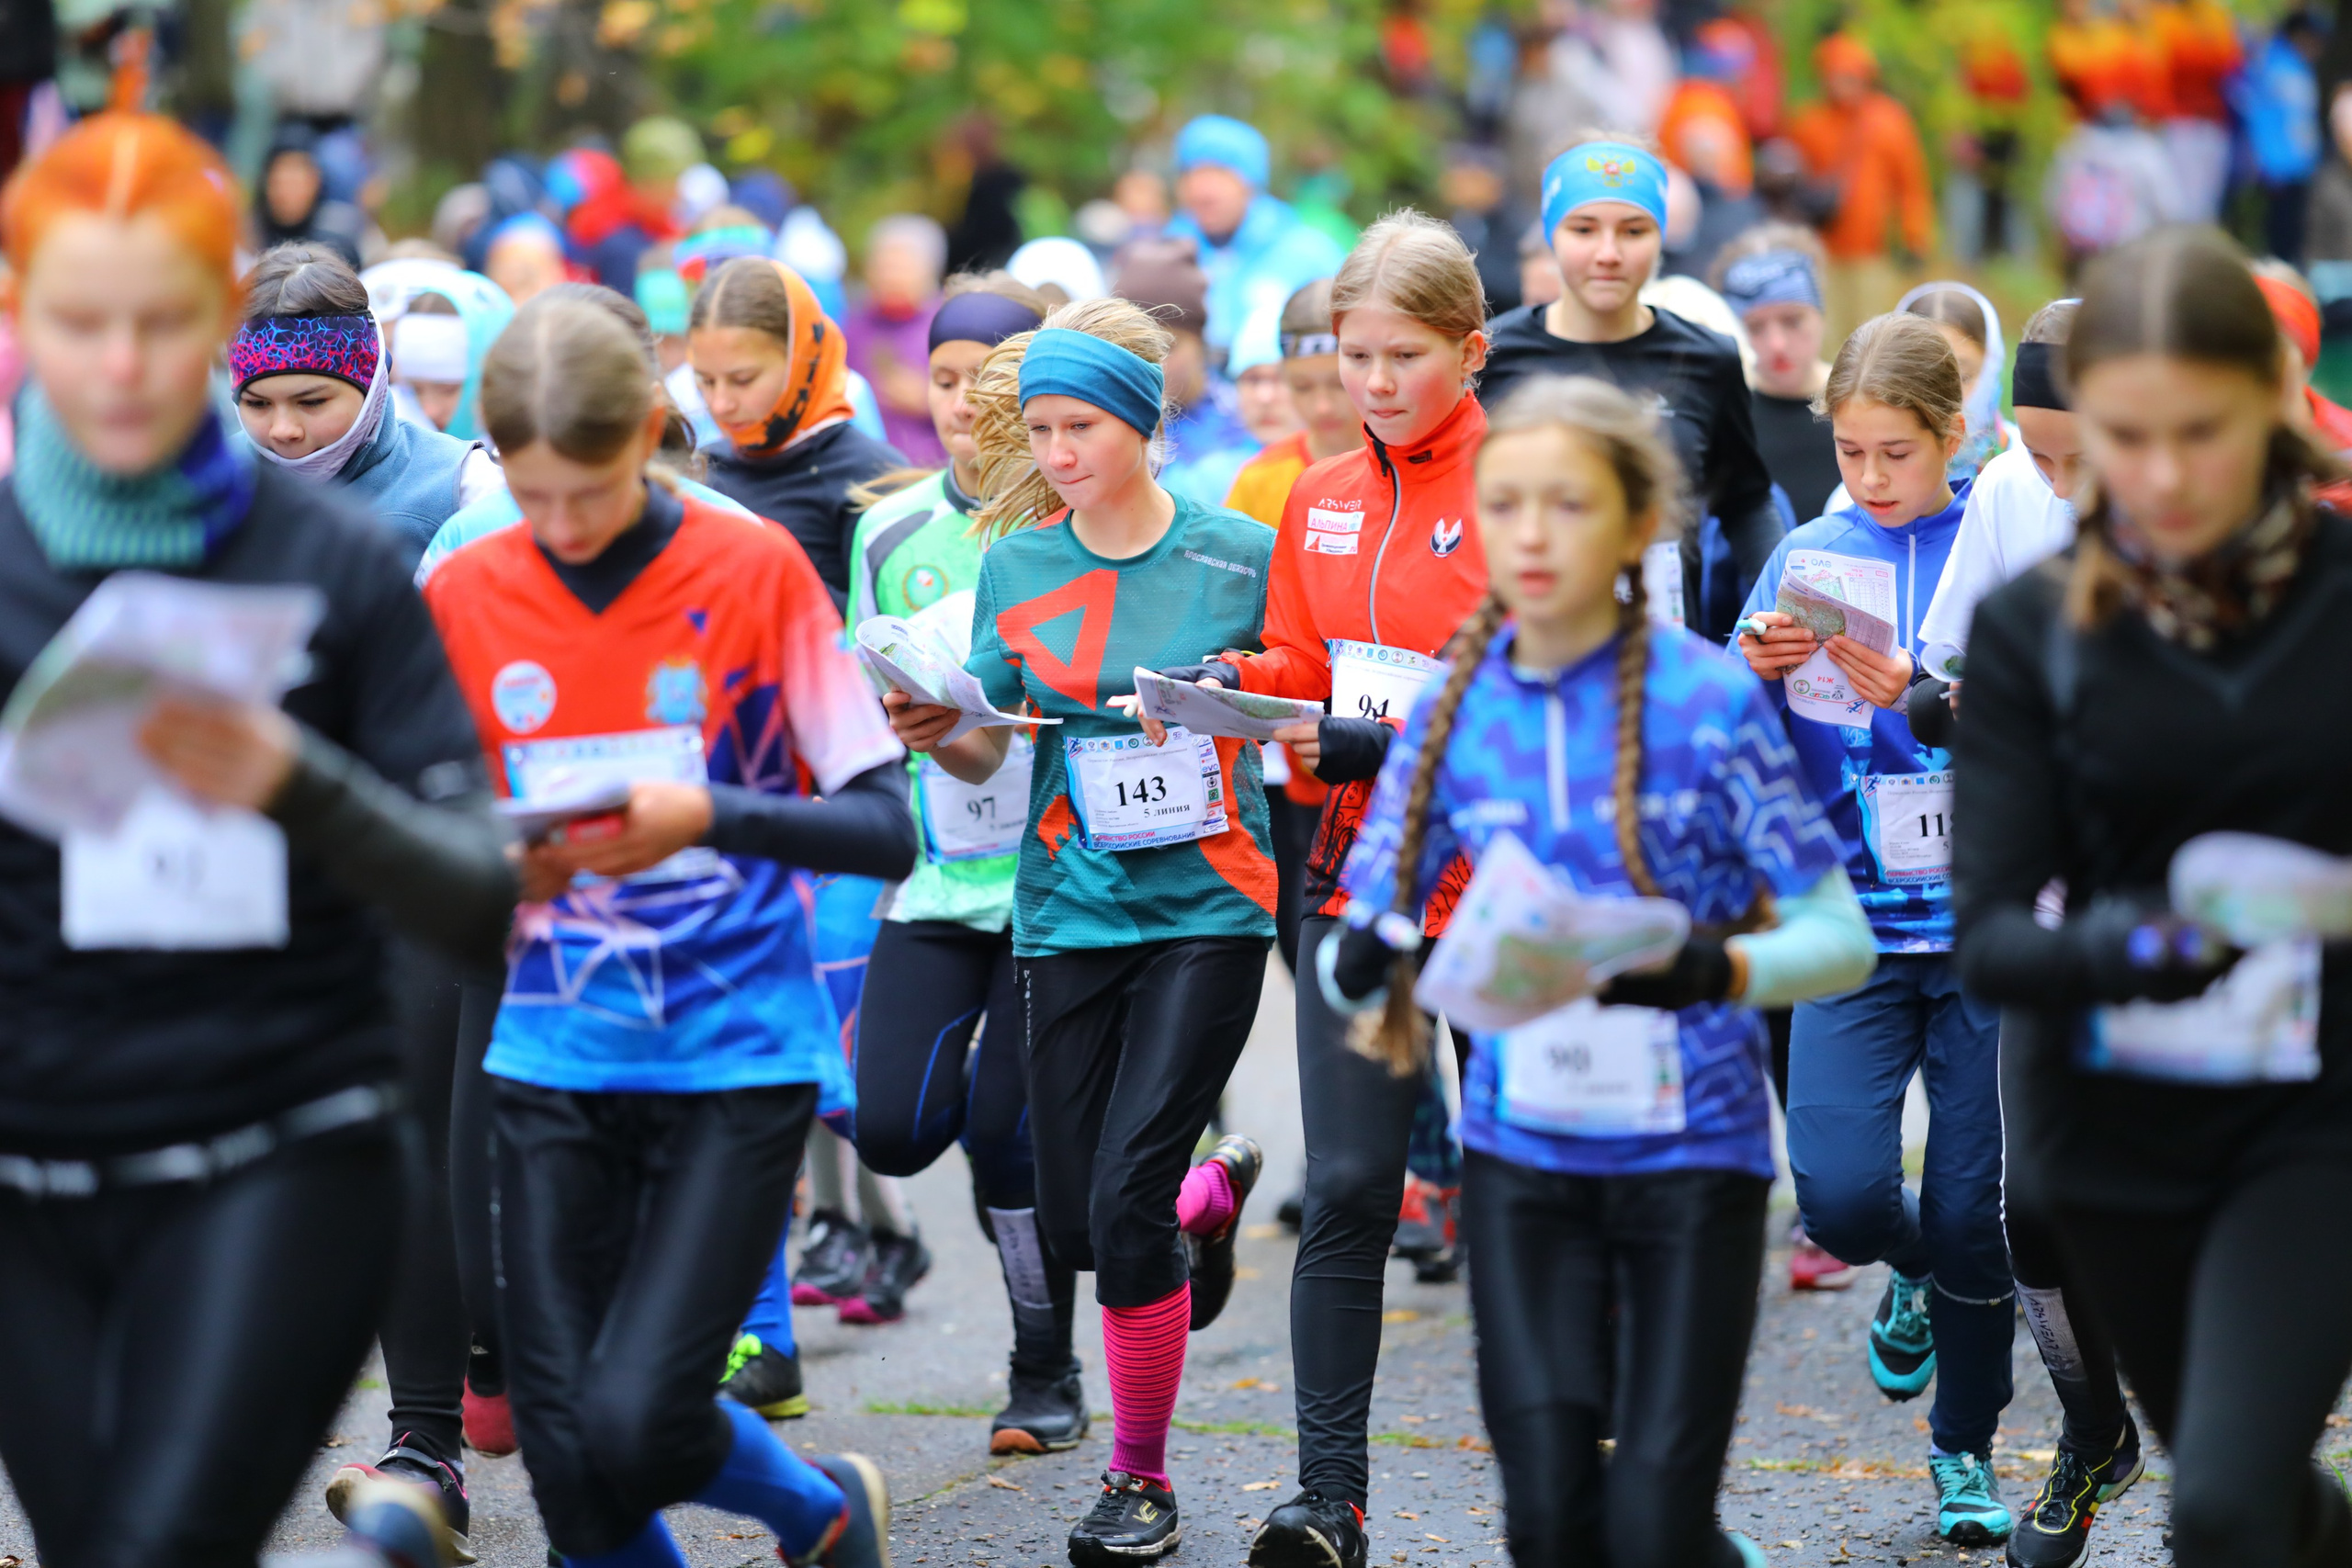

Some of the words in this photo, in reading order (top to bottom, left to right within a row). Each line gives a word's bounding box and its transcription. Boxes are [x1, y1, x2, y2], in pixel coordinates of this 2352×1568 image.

[1310, 518, 1348, 531] АЛЬПИНА
[1358, 694, 1389, 721] 94
[1202, 763, 1218, 773] evo
[1114, 775, 1167, 807] 143
[967, 796, 997, 821] 97
[1144, 808, 1150, 818] 5
[1917, 812, 1954, 838] 11
[1128, 830, 1156, 841] РОССИИ
[1142, 830, 1196, 846] СОРЕВНОВАНИЯ
